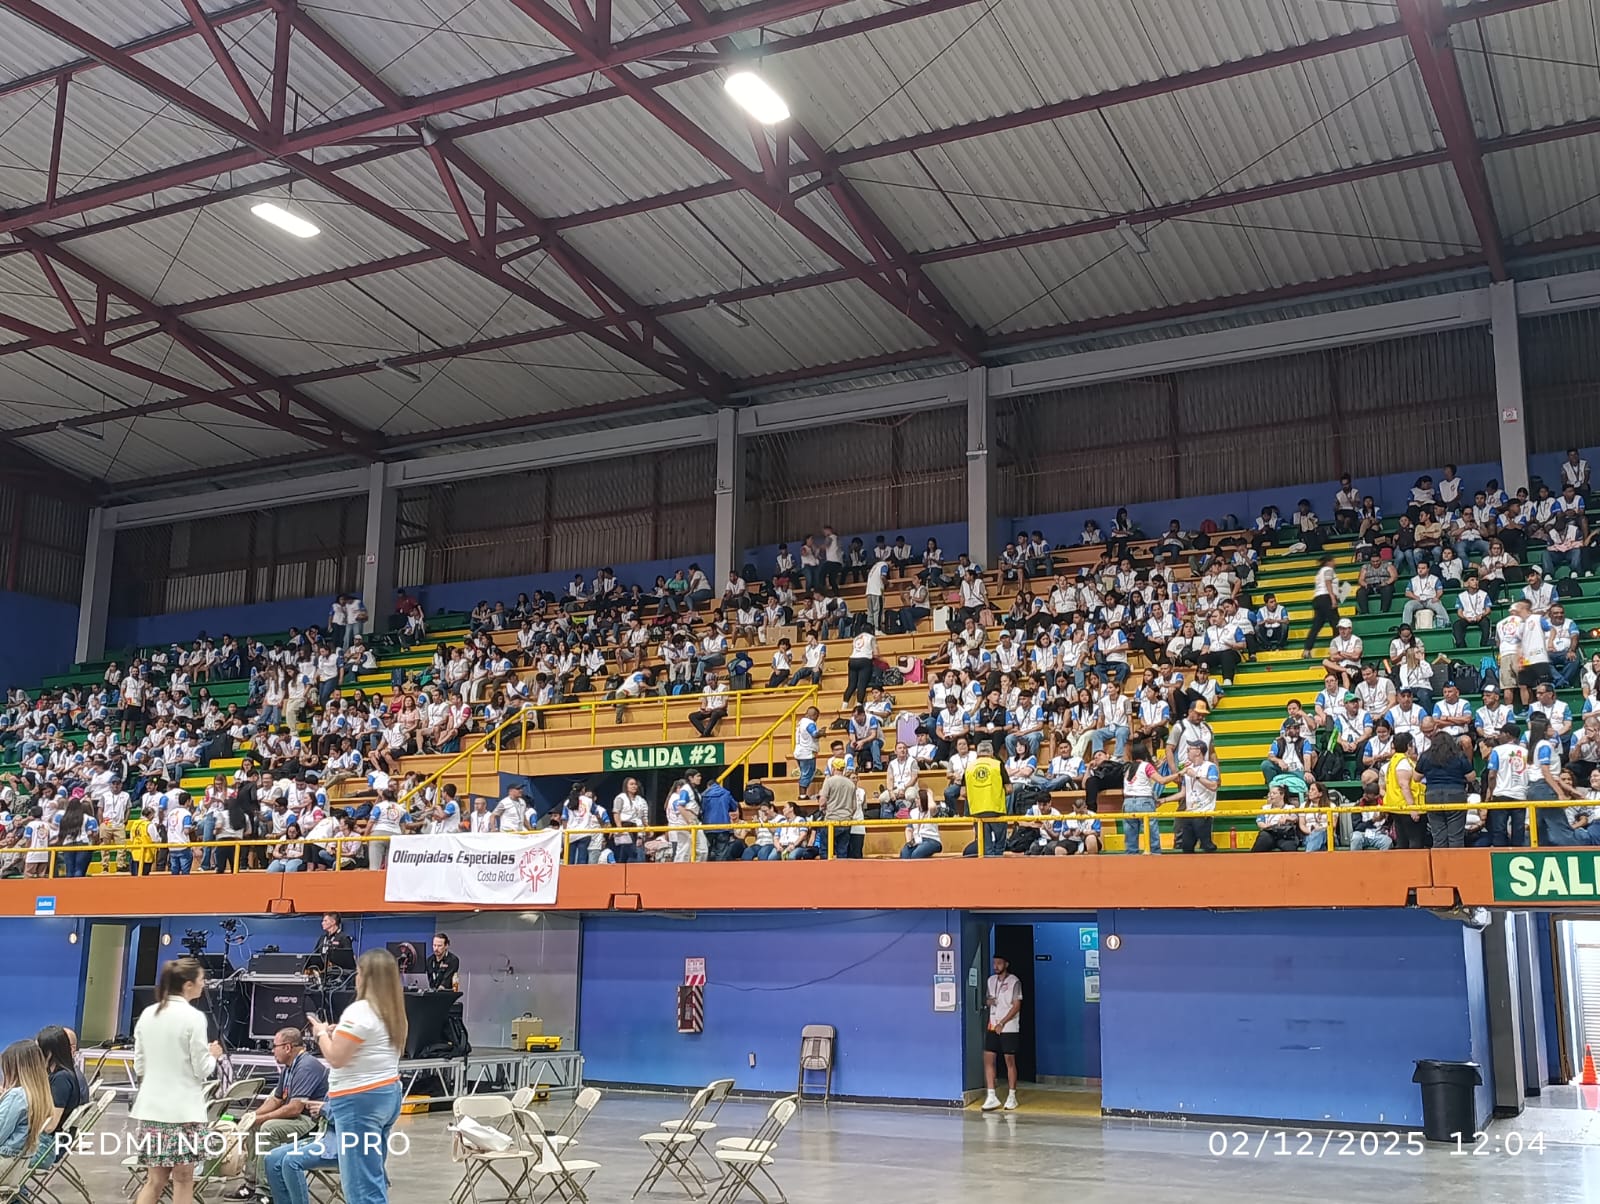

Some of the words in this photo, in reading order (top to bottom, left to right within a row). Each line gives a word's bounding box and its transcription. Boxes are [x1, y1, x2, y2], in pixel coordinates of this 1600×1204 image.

[610, 746, 684, 769] SALIDA
[689, 744, 717, 764] #2
[392, 850, 453, 866] Olimpiadas
[456, 851, 515, 867] Especiales
[477, 870, 497, 882] Costa
[499, 870, 515, 882] Rica
